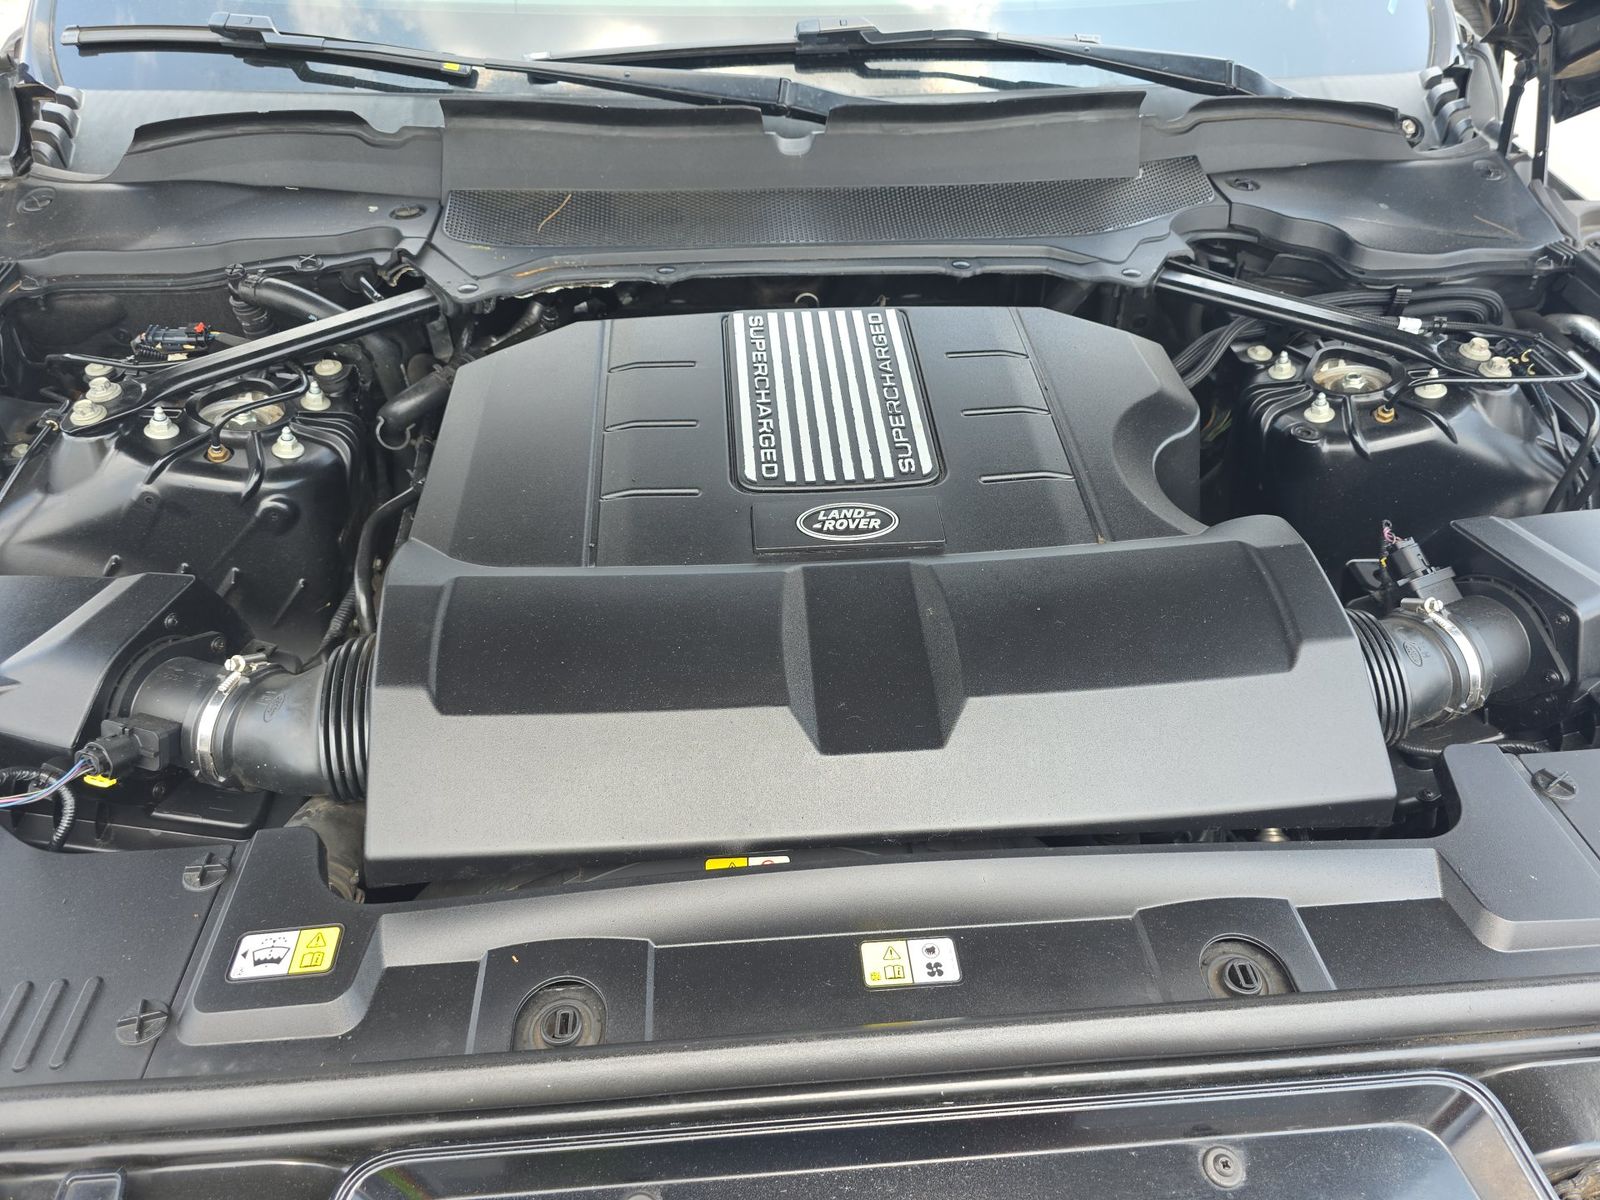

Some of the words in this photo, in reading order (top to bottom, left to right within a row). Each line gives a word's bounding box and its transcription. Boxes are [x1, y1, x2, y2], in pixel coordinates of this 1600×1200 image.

[748, 315, 779, 479] SUPERCHARGED
[867, 312, 916, 475] SUPERCHARGED
[817, 508, 865, 520] LAND
[822, 518, 882, 531] ROVER
